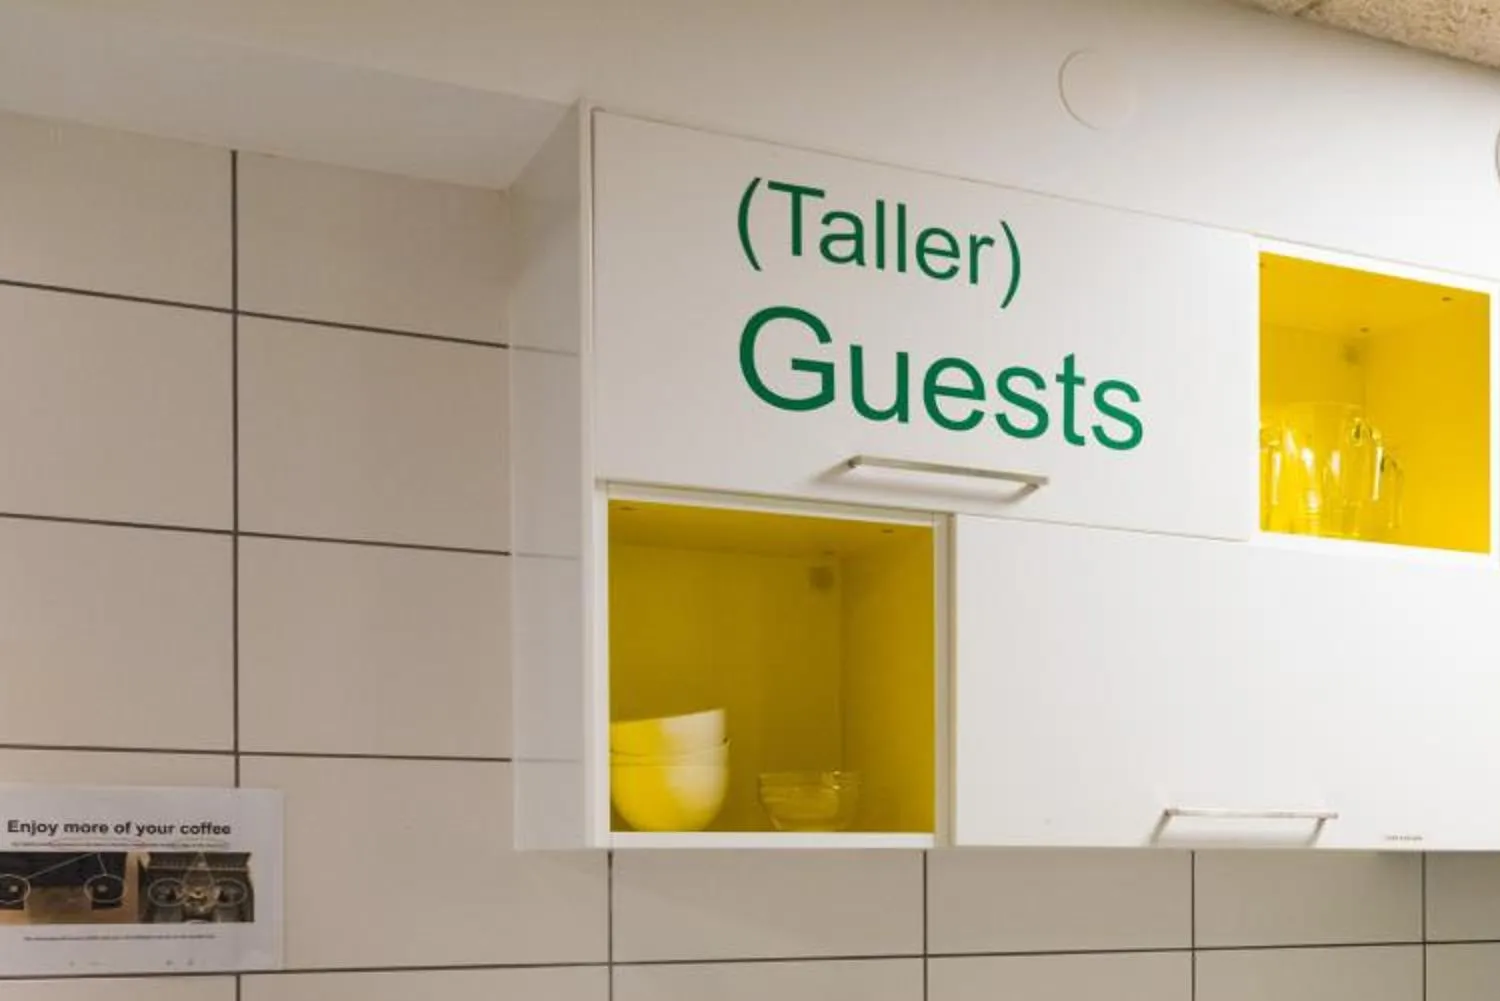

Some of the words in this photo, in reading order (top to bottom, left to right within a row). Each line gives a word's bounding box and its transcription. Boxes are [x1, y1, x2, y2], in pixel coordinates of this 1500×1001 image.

[737, 177, 1021, 309] (Taller)
[738, 306, 1144, 451] Guests
[7, 819, 59, 836] Enjoy
[63, 823, 109, 834] more
[113, 821, 131, 834] of
[135, 824, 176, 837] your
[180, 822, 231, 835] coffee
